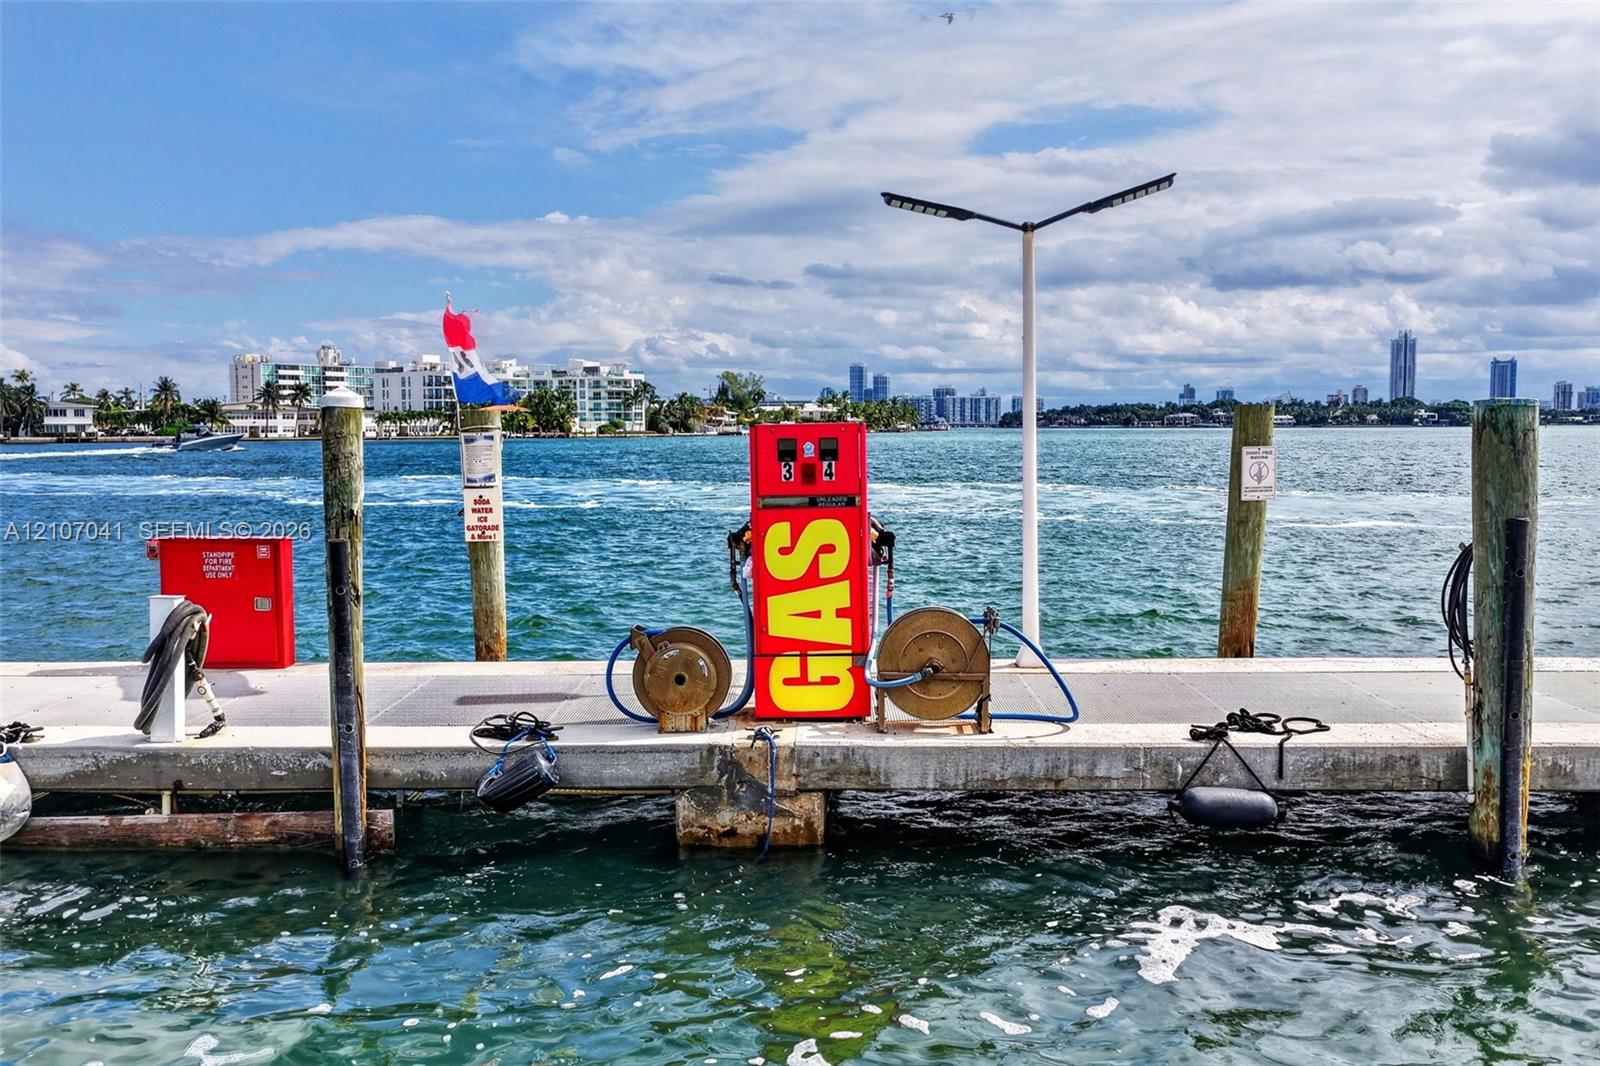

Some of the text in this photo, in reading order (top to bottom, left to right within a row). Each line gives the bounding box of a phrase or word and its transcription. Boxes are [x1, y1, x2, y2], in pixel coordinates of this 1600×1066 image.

[783, 462, 792, 480] 3
[824, 461, 834, 480] 4
[764, 518, 855, 712] GAS
